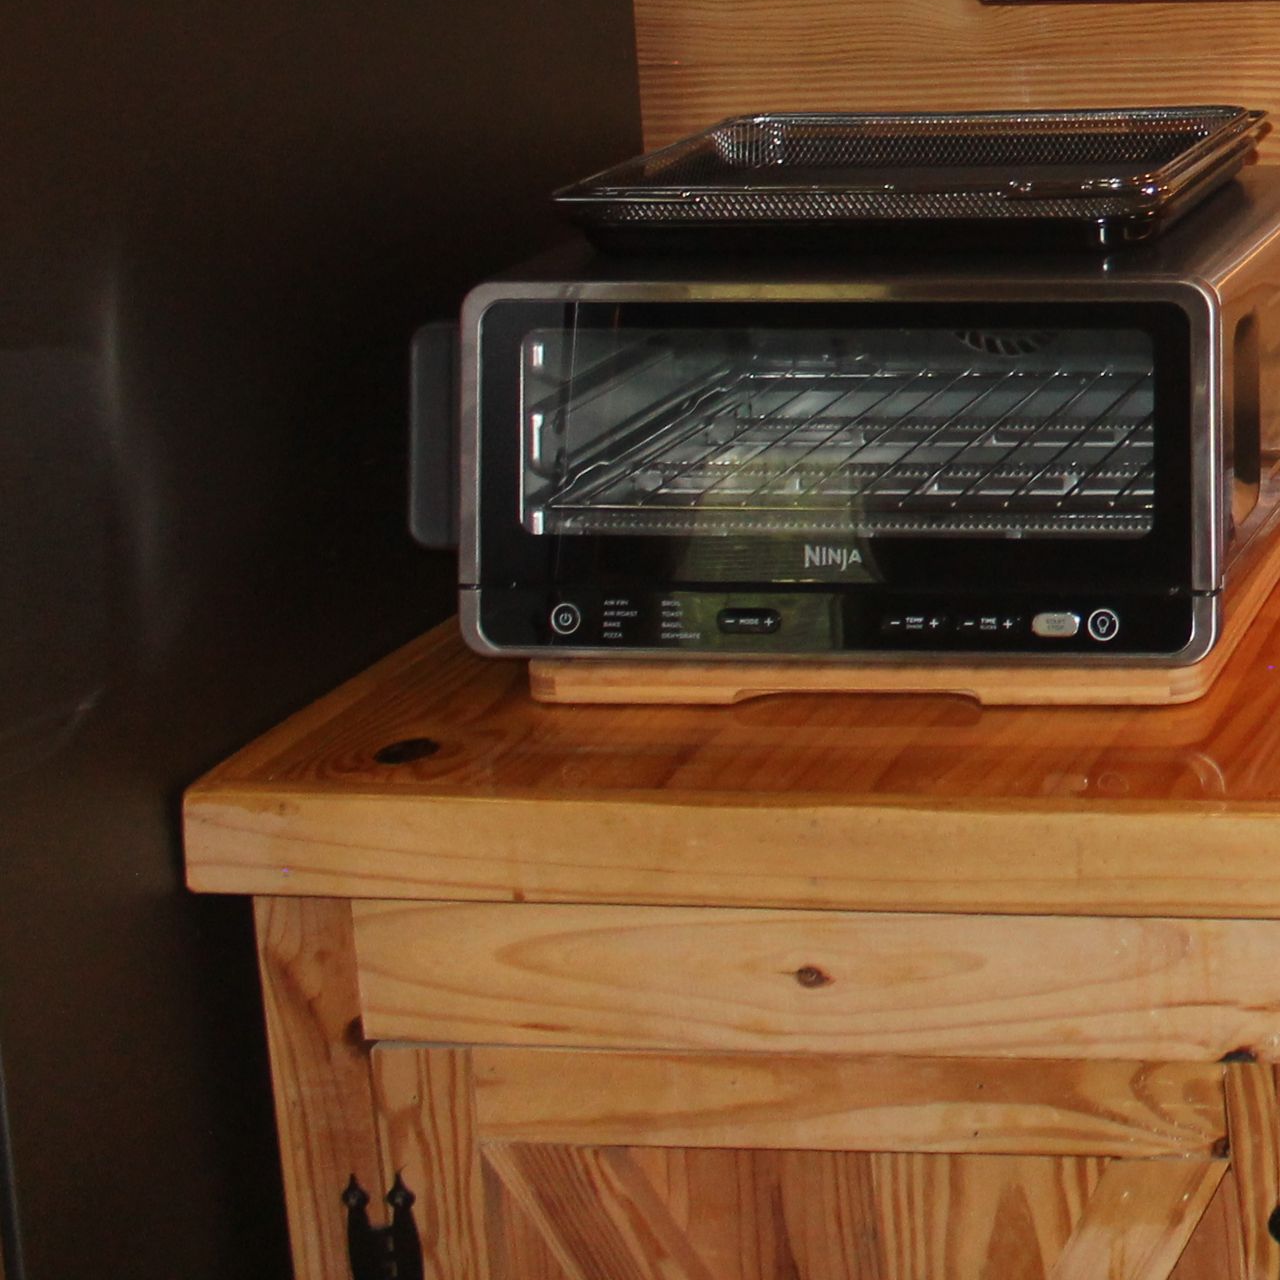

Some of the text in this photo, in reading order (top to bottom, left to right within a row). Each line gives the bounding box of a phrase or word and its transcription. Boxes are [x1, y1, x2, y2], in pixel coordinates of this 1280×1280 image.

[804, 543, 862, 572] NINJA
[738, 618, 760, 626] MODE
[905, 616, 924, 624] TEMP
